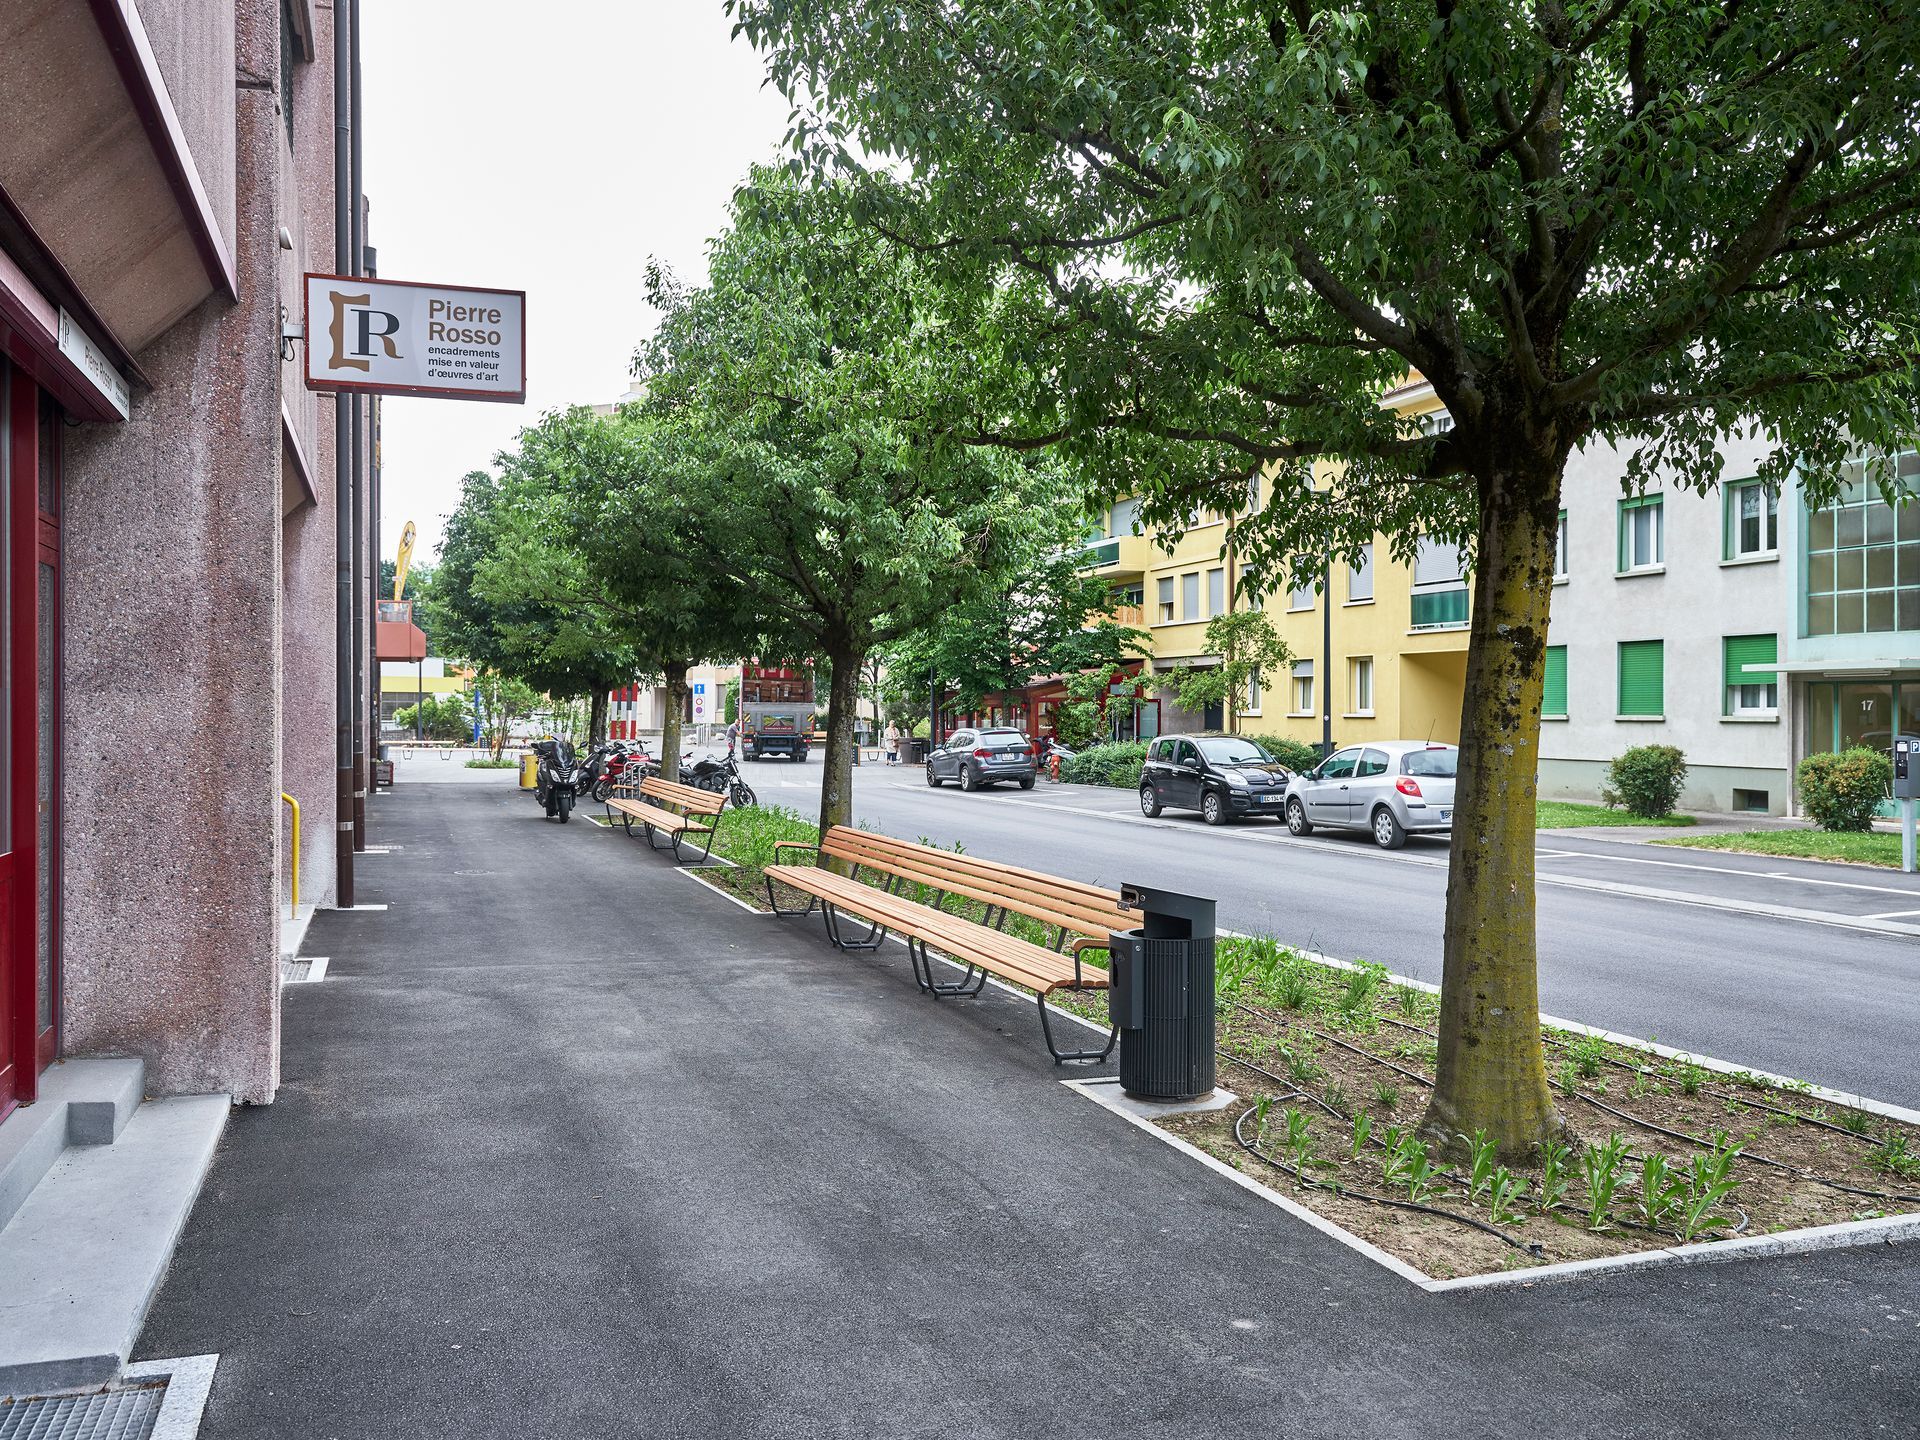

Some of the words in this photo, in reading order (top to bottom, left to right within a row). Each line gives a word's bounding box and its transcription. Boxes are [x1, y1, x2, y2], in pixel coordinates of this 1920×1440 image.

[429, 299, 501, 324] Pierre
[429, 321, 501, 346] Rosso
[428, 346, 500, 359] encadrements
[85, 345, 99, 377] Pierre
[428, 357, 452, 367] mise
[454, 360, 467, 368] en
[469, 360, 500, 370] valeur
[475, 371, 499, 382] d'art
[1861, 700, 1874, 711] 17
[1912, 743, 1918, 752] P
